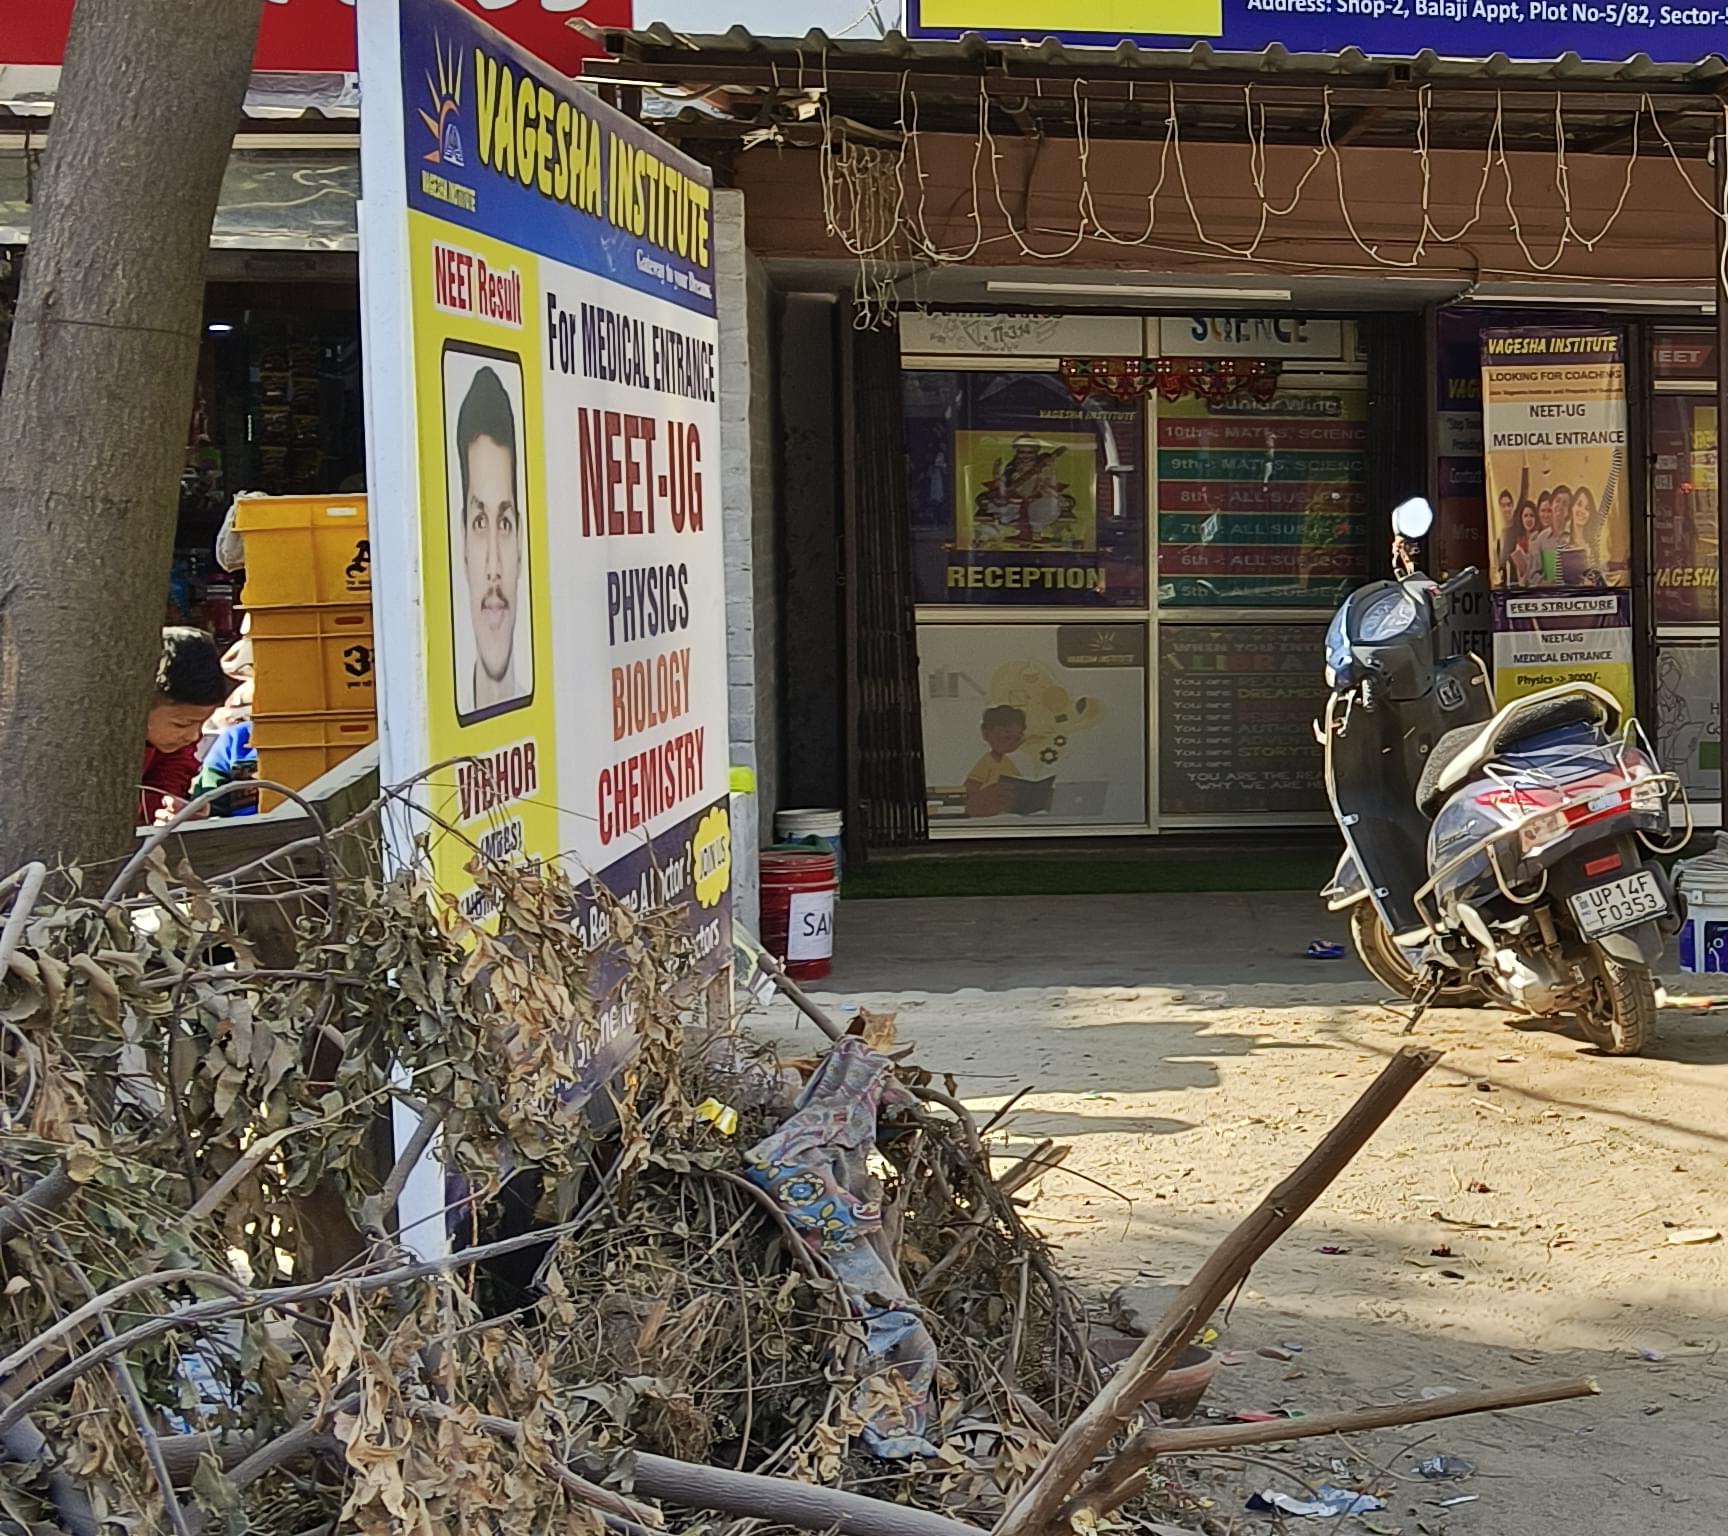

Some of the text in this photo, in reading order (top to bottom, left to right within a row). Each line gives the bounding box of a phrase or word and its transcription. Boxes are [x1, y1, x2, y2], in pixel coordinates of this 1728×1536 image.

[1529, 0, 1569, 23] Plot
[1572, 1, 1656, 31] No-5/82,
[475, 47, 709, 268] VAGESHA INSTITUTE
[434, 245, 523, 325] NEET Result
[547, 292, 716, 403] For MEDICAL ENTRANCE
[1488, 335, 1618, 355] VAGESHA INSTITUTE
[1489, 369, 1622, 382] LOOKING FOR COACHING
[1529, 403, 1586, 419] NEET-UG
[1493, 430, 1625, 447] MEDICAL ENTRANCE
[577, 407, 704, 538] NEET-UG
[947, 565, 1106, 590] RECEPTION
[606, 563, 690, 646] PHYSICS
[1510, 599, 1614, 614] FEES STRUCTURE
[1541, 633, 1584, 644] NEET-UG
[1513, 650, 1613, 664] MEDICAL ENTRANCE
[1517, 673, 1554, 686] Physics
[611, 647, 691, 742] BIOLOGY
[599, 726, 706, 846] CHEMISTRY
